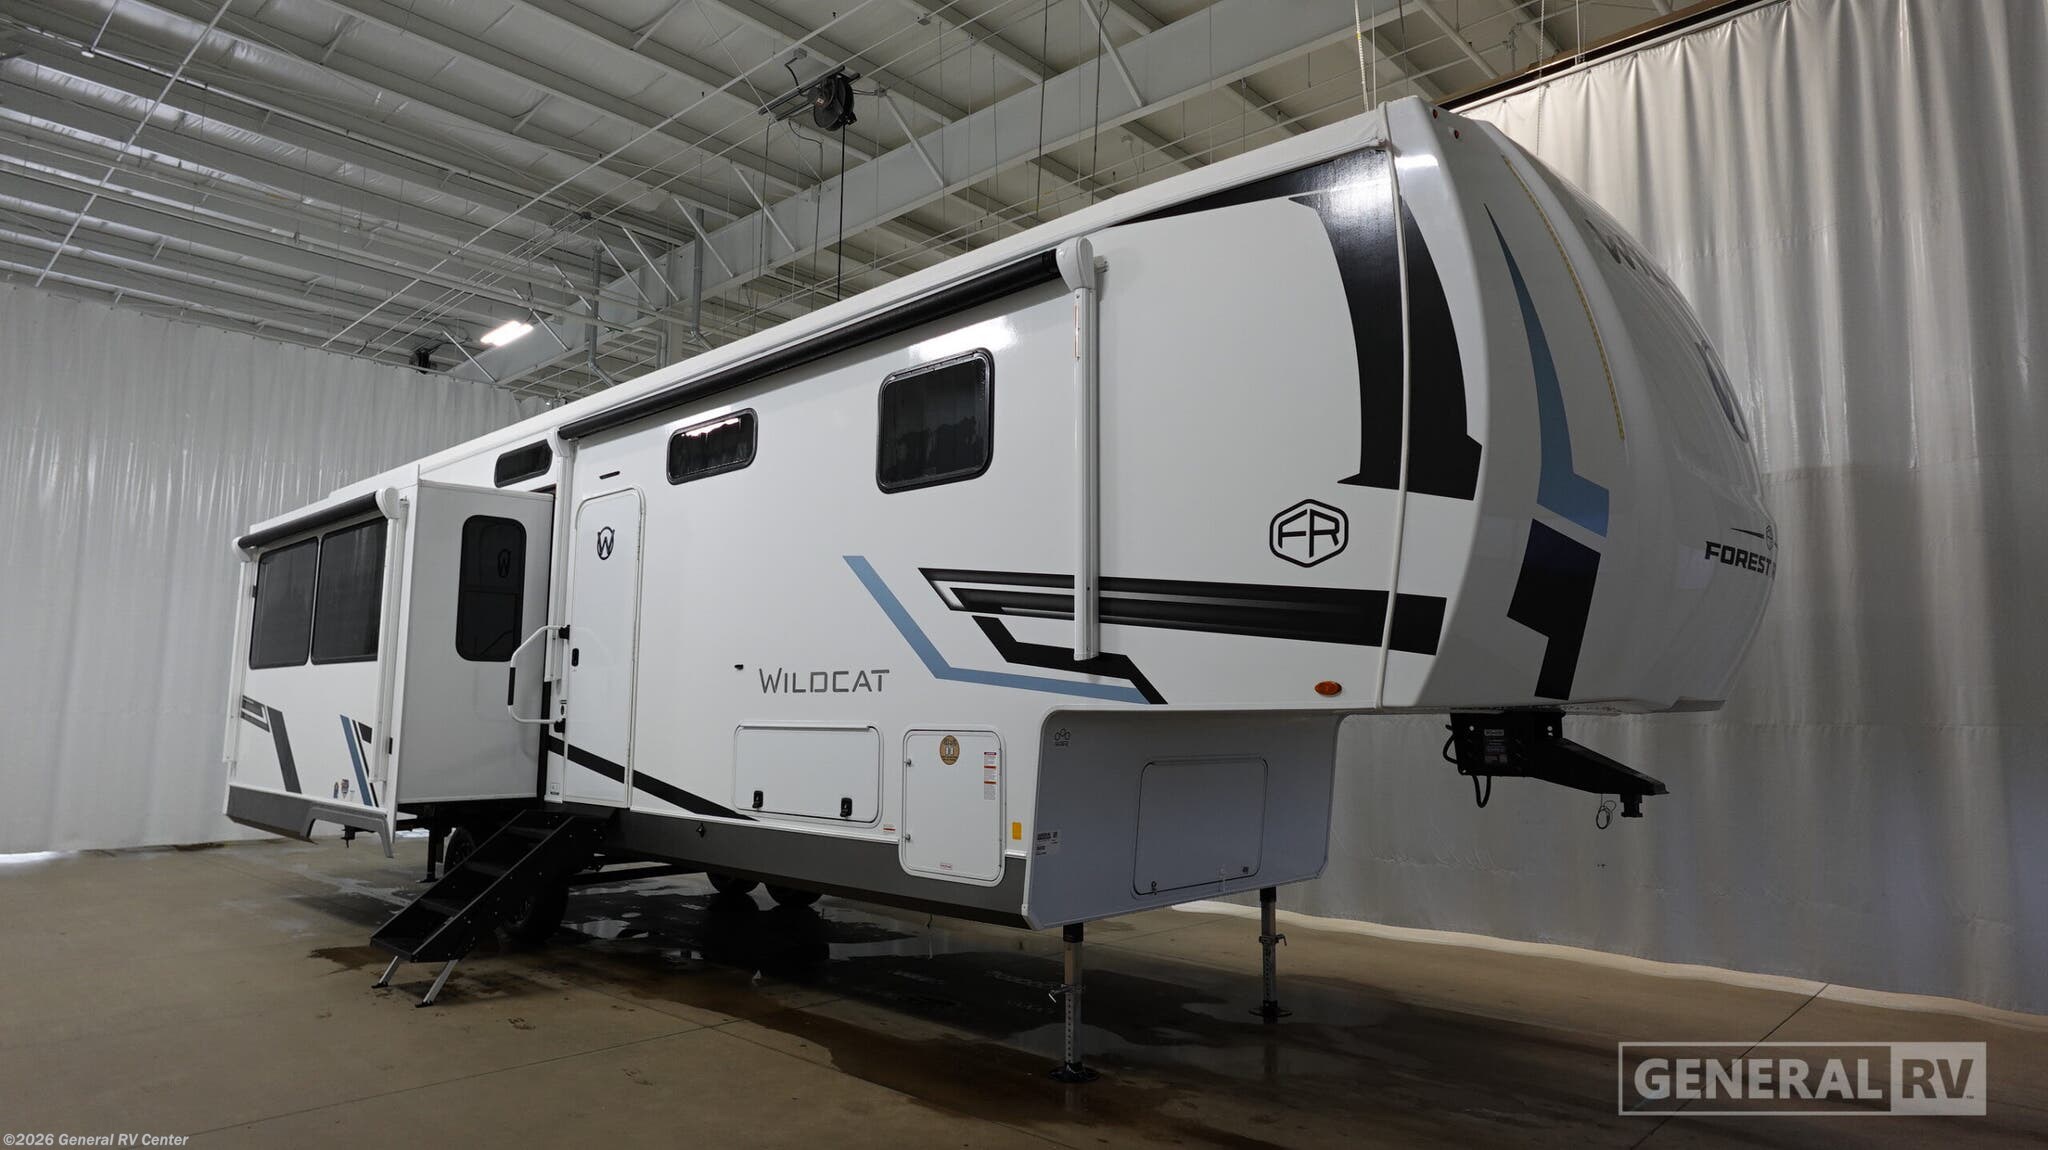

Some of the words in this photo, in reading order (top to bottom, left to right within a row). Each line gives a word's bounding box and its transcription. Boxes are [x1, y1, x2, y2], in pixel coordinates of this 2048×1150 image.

[597, 528, 615, 559] W
[1705, 541, 1772, 576] FOREST
[759, 667, 890, 694] WILDCAT
